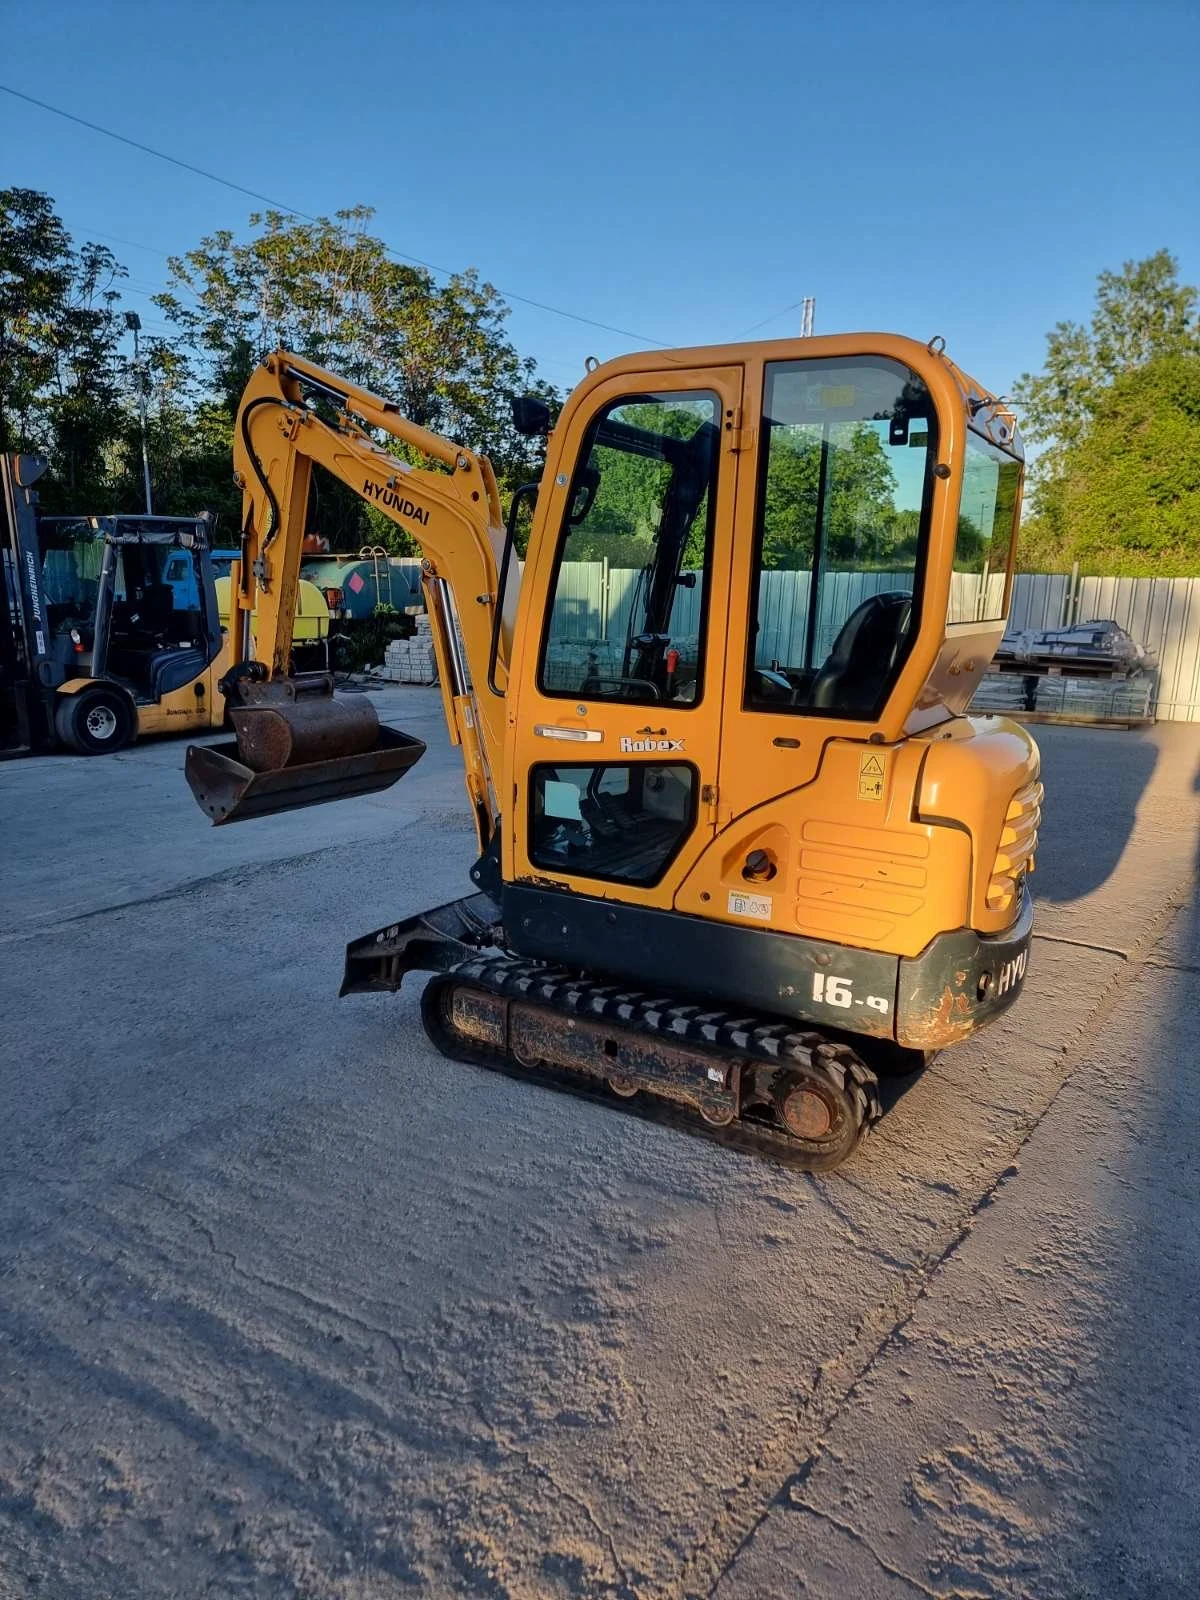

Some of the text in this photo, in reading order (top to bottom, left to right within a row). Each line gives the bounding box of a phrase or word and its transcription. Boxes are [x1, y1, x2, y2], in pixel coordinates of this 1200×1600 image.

[363, 479, 430, 526] HYUNDAI
[25, 551, 42, 622] JUNGHEINRICH
[619, 736, 687, 752] Robex
[812, 972, 889, 1015] 16-9
